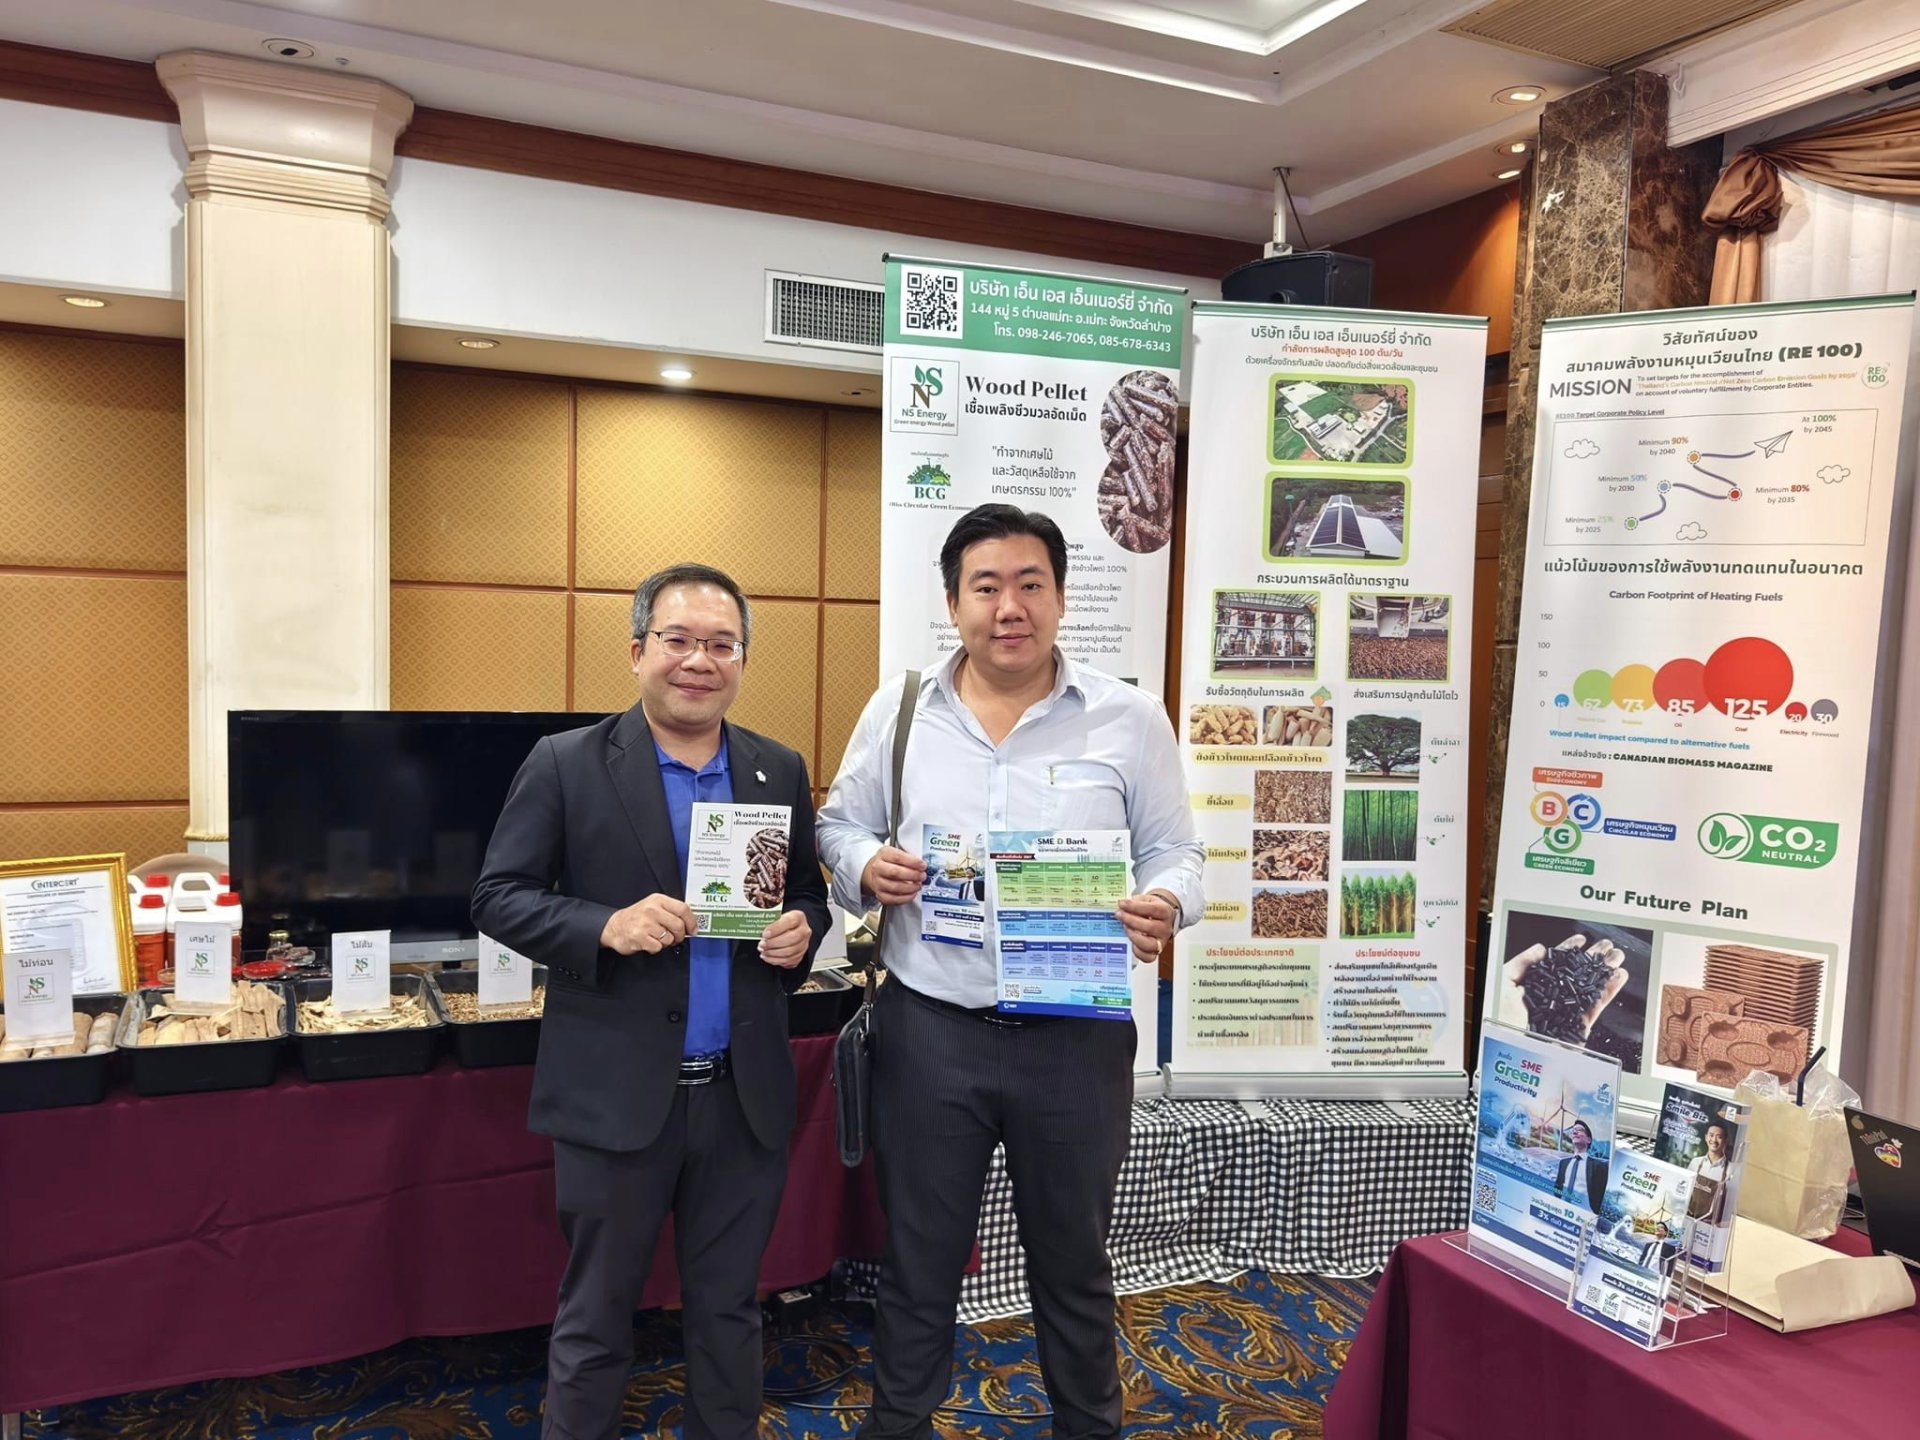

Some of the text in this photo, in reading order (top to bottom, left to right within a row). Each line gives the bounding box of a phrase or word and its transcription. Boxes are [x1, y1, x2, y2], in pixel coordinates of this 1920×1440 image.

[970, 279, 1173, 315] บริษัท เอ็น เอส เอ็นเนอร์ยี่ จำกัด
[971, 303, 991, 314] 144
[995, 304, 1009, 320] หมู่
[1012, 307, 1019, 317] 5
[1022, 306, 1073, 323] ตำบลแม่ทะ
[1110, 316, 1171, 333] จังหวัดลำปาง
[994, 322, 1171, 352] โทร. 098-246-7065, 085-678-6343
[1252, 325, 1431, 346] บริษัท เอ็น เอส เอ็นเนอร์ยี่ จำกัด
[1663, 329, 1758, 346] วิสัยทัศน์ของ
[1282, 343, 1356, 357] กำลังการผลิตสูงสุด
[1377, 349, 1403, 357] ตัน/วัน
[1566, 343, 1863, 373] สมาคมพลังงานหมุนเวียนไทย (RE 100)
[1657, 374, 1679, 382] targets
[1702, 370, 1753, 378] accomplishment
[1867, 374, 1885, 383] 100
[1868, 367, 1881, 375] RE
[966, 375, 1088, 401] Wood Pellet
[1550, 378, 1632, 398] MISSION
[902, 409, 947, 420] NS Energy
[965, 398, 1087, 422] เชื้อเพลิงชีวมวลอัดเม็ด
[1628, 409, 1646, 417] Policy
[1812, 414, 1837, 423] 100%
[1804, 426, 1812, 434] by
[1672, 436, 1689, 445] 90%
[992, 446, 1053, 460] "ทำจากเศษไม้
[992, 465, 1076, 480] และวัสดุเหลือใช้จาก
[1630, 474, 1648, 482] 50%
[915, 487, 946, 500] BCG
[992, 485, 1076, 498] เกษตรกรรม 100%"
[1756, 484, 1810, 494] Minimum 80%
[1544, 557, 1863, 576] แน้วโน้มของการใช้พลังงานทดแทนในอนาคต
[1257, 573, 1409, 589] กระบวนการผลิตได้มาตราฐาน
[1609, 590, 1783, 603] Carbon Footprint of Heating Fuels
[1354, 689, 1458, 702] ส่งเสริมการปลูกต้นไม้โตไว
[1622, 698, 1644, 713] 73
[1667, 698, 1695, 716] 85
[1724, 698, 1768, 720] 125
[1816, 713, 1833, 724] 30
[1550, 729, 1750, 750] Wood Pellet impact compared to alternative fuels
[1779, 729, 1808, 737] Electricity
[1613, 752, 1666, 764] CANADIAN
[1667, 756, 1715, 768] BIOMASS
[1717, 761, 1773, 773] MAGAZINE
[762, 811, 787, 819] Pellet
[1542, 801, 1589, 820] B C
[930, 837, 960, 848] Green
[947, 833, 961, 841] SME
[1066, 837, 1087, 845] Bank
[1554, 828, 1570, 844] G
[1762, 849, 1820, 864] NEUTRAL
[1580, 885, 1748, 920] Our Future Plan
[1495, 1060, 1541, 1087] Green
[1520, 1059, 1543, 1074] SME
[1494, 1076, 1538, 1098] Productivity
[1666, 1102, 1691, 1117] Smile
[1692, 1110, 1707, 1122] Biz
[1622, 1171, 1657, 1191] Green
[1643, 1171, 1662, 1182] SME
[1621, 1182, 1654, 1199] Productivity
[1537, 1210, 1549, 1220] 3%
[1564, 1209, 1574, 1219] 10
